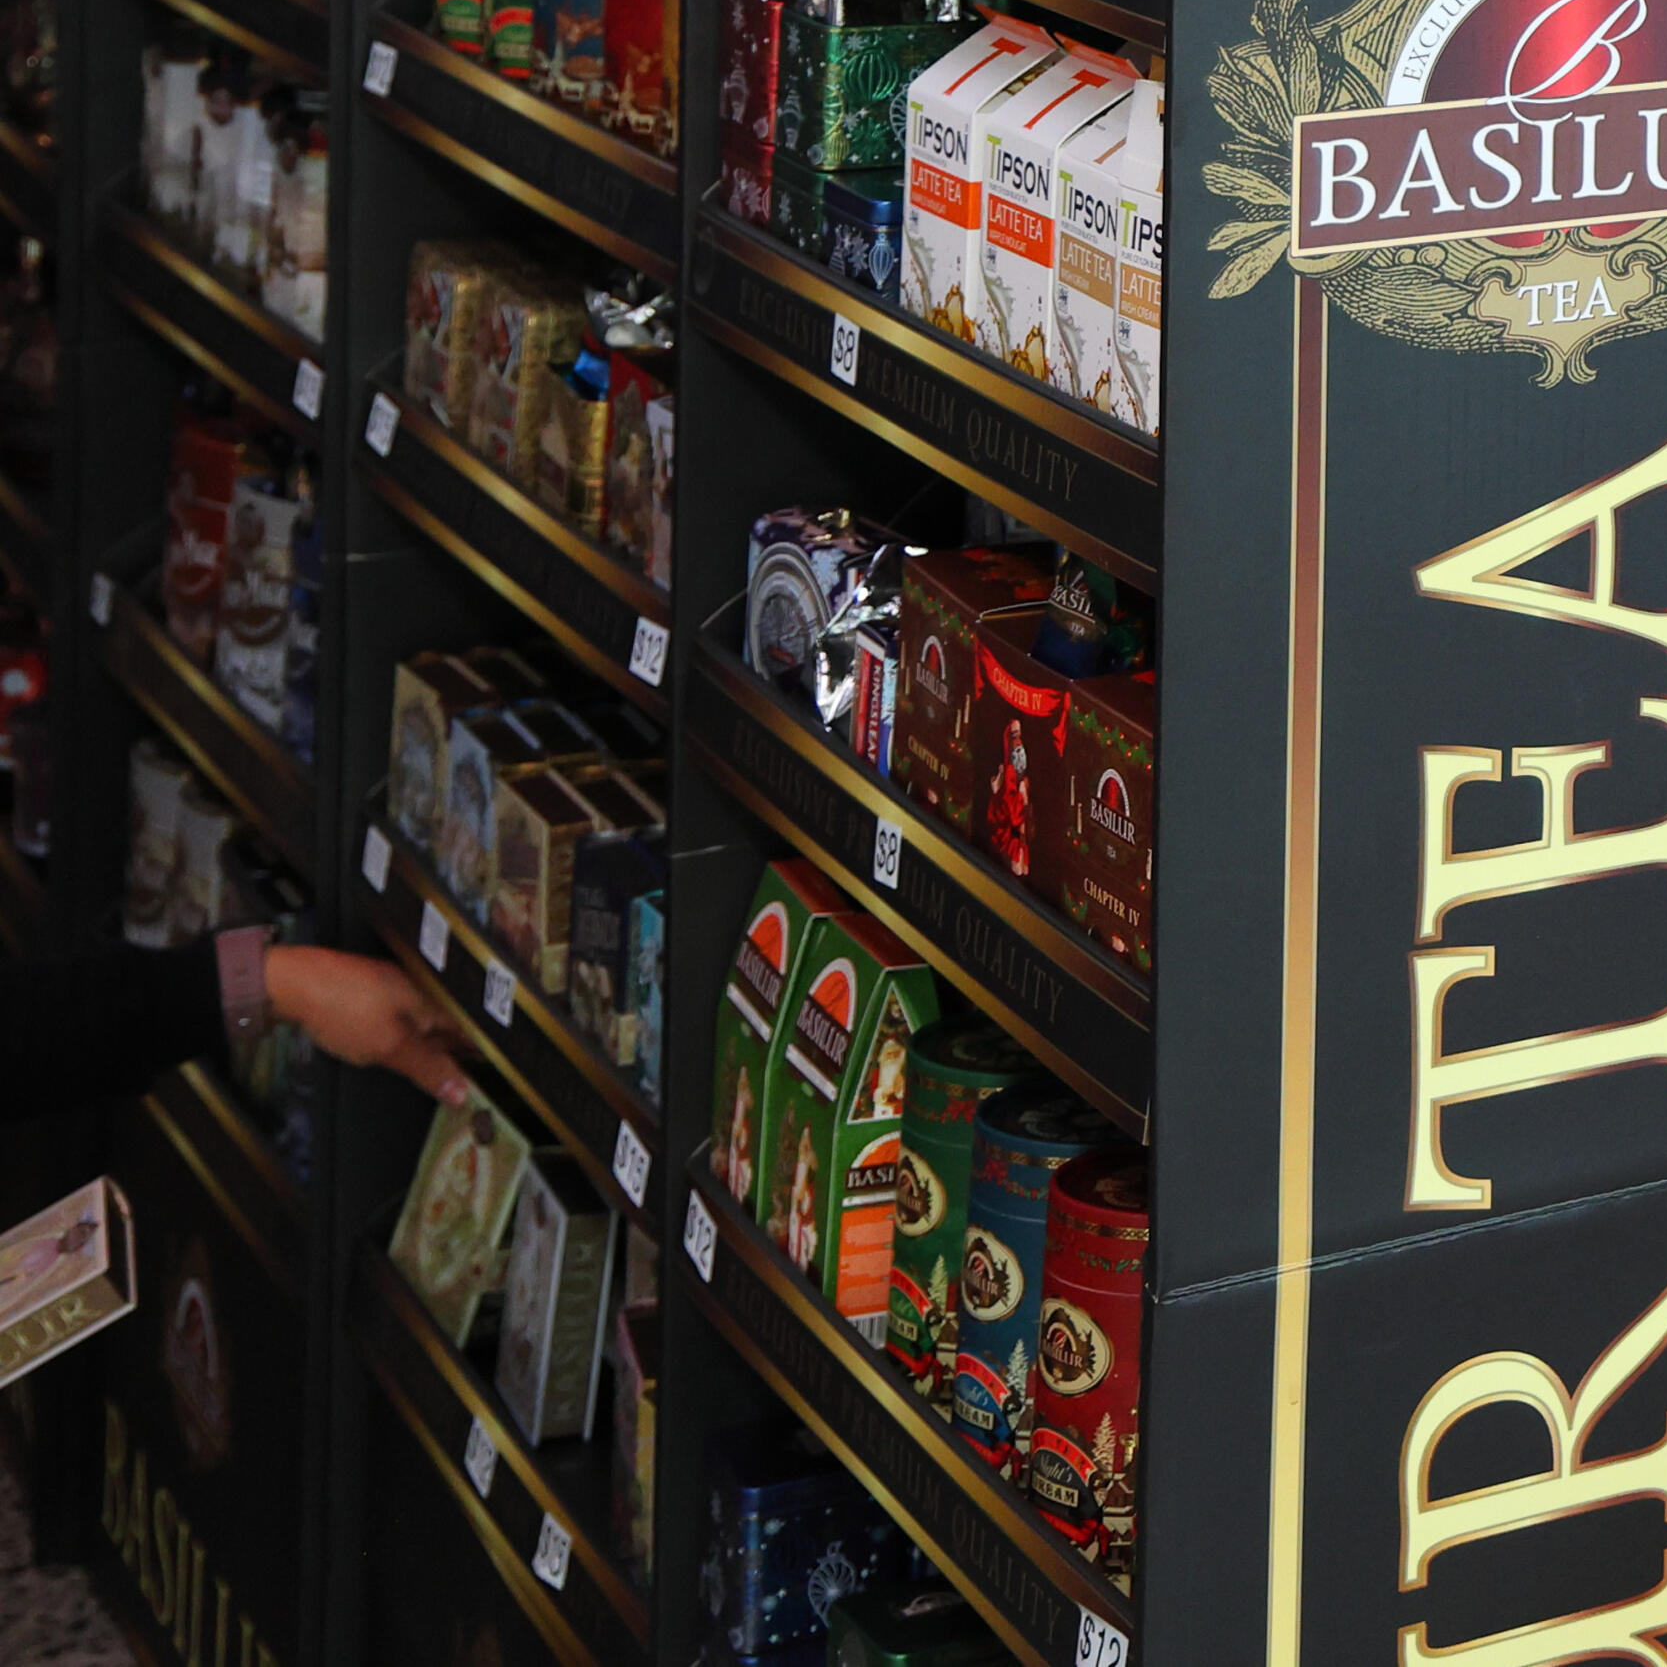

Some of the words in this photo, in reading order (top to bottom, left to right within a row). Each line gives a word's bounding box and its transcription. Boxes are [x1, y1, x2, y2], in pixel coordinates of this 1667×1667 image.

[910, 101, 968, 166] TIPSON
[987, 134, 1050, 202] TIPSON
[988, 197, 1021, 235] LATTE
[1021, 211, 1044, 243] TEA
[1059, 169, 1119, 242] TIPSON
[1060, 237, 1092, 274] LATTE
[1092, 256, 1113, 285] TEA
[1517, 275, 1618, 327] TEA
[834, 325, 856, 374] $8
[867, 663, 884, 765] KINGSLEAF
[992, 667, 1031, 710] CHAPTER
[1030, 693, 1043, 713] IV
[907, 734, 937, 776] CHAPTER
[937, 763, 950, 783] IV
[1090, 796, 1137, 846] BASILUR
[877, 830, 899, 873] $8
[1083, 876, 1126, 923] CHAPTER
[1126, 904, 1141, 928] IV
[800, 994, 849, 1062] BASILUR
